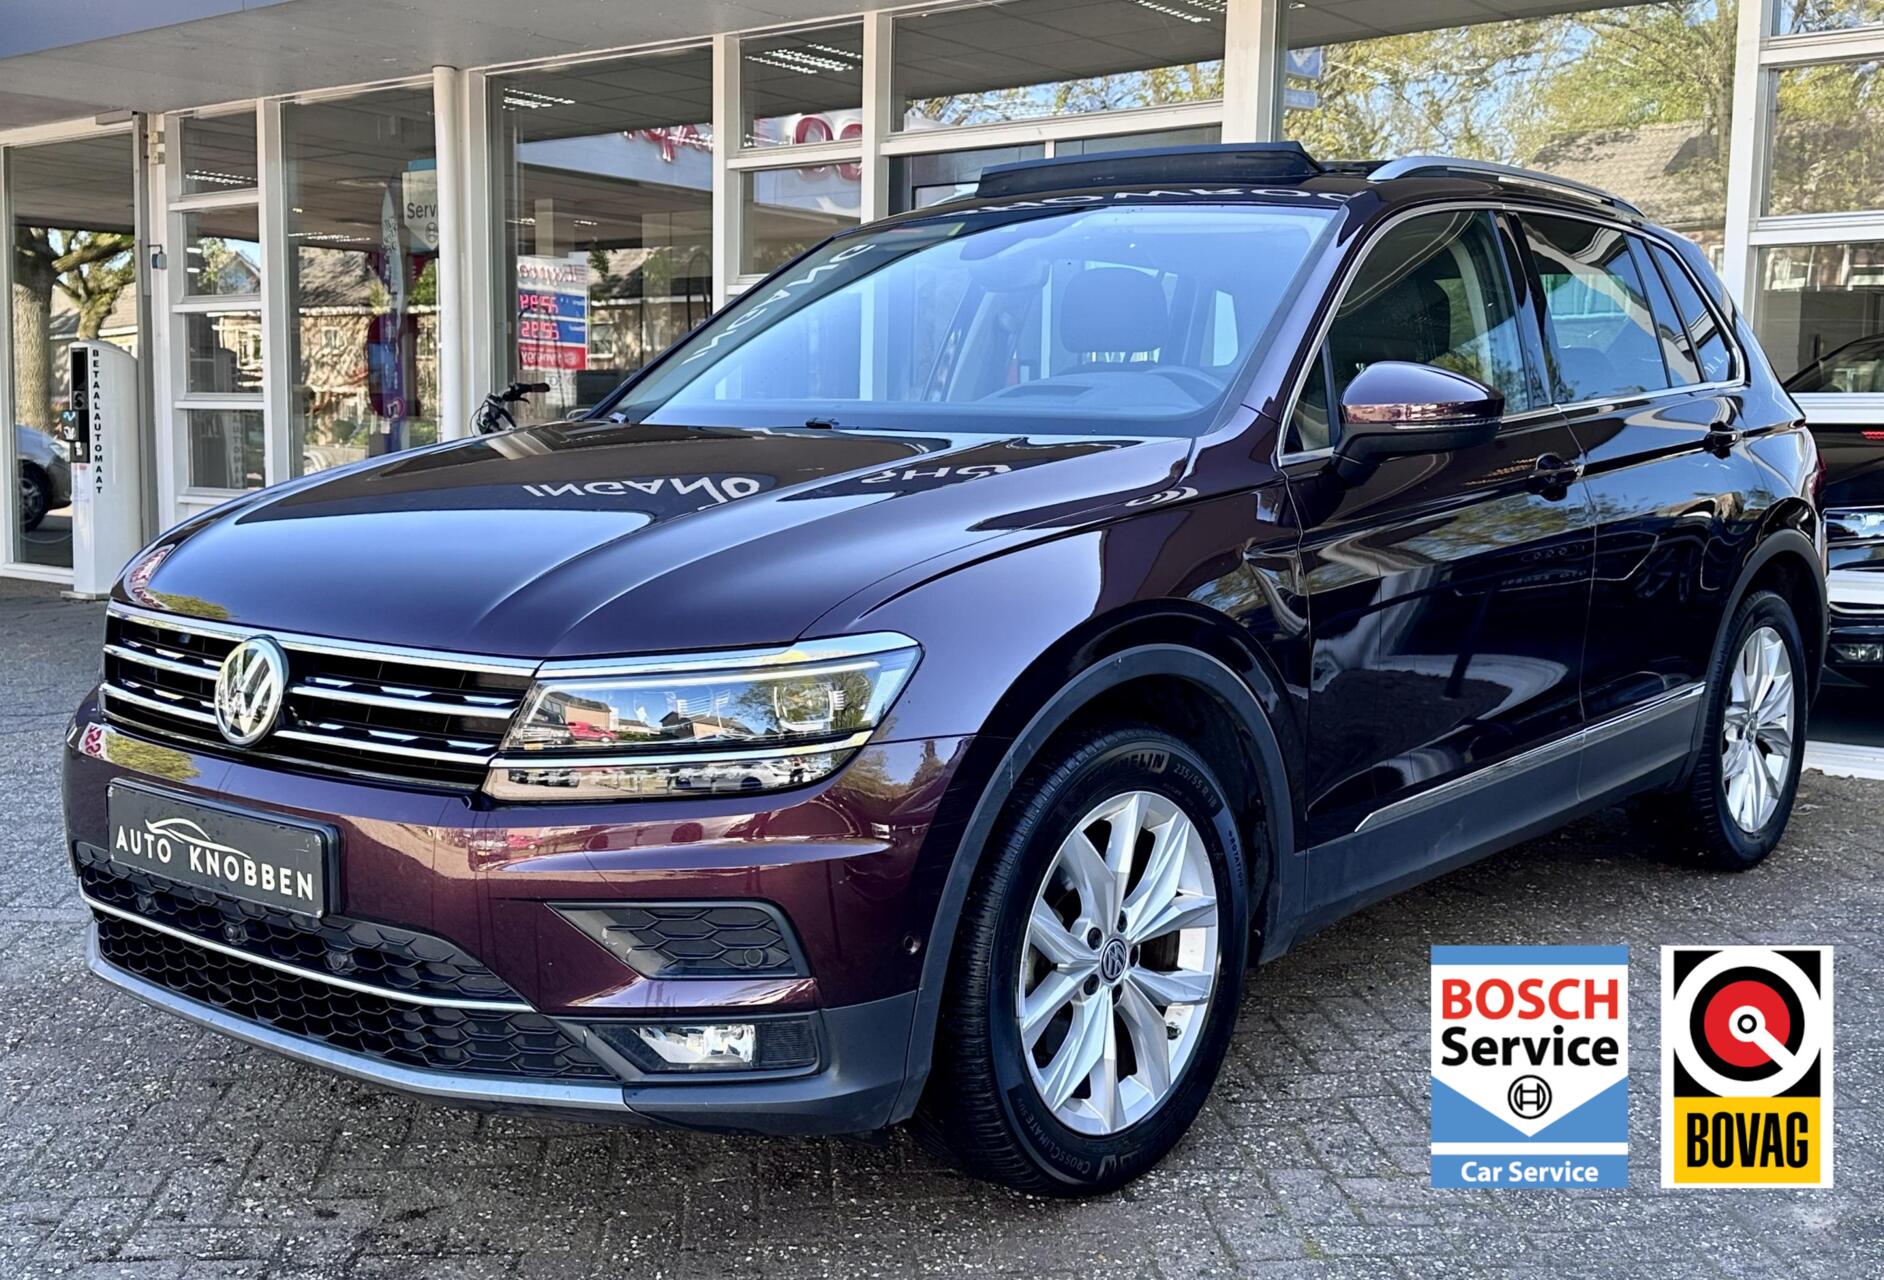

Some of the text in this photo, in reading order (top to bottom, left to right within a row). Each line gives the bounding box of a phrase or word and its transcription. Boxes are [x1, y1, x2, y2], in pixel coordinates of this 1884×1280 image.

[406, 202, 437, 219] Serv
[92, 349, 103, 494] BETAALAUTOMAAT
[115, 825, 313, 901] AUTO KNOBBEN
